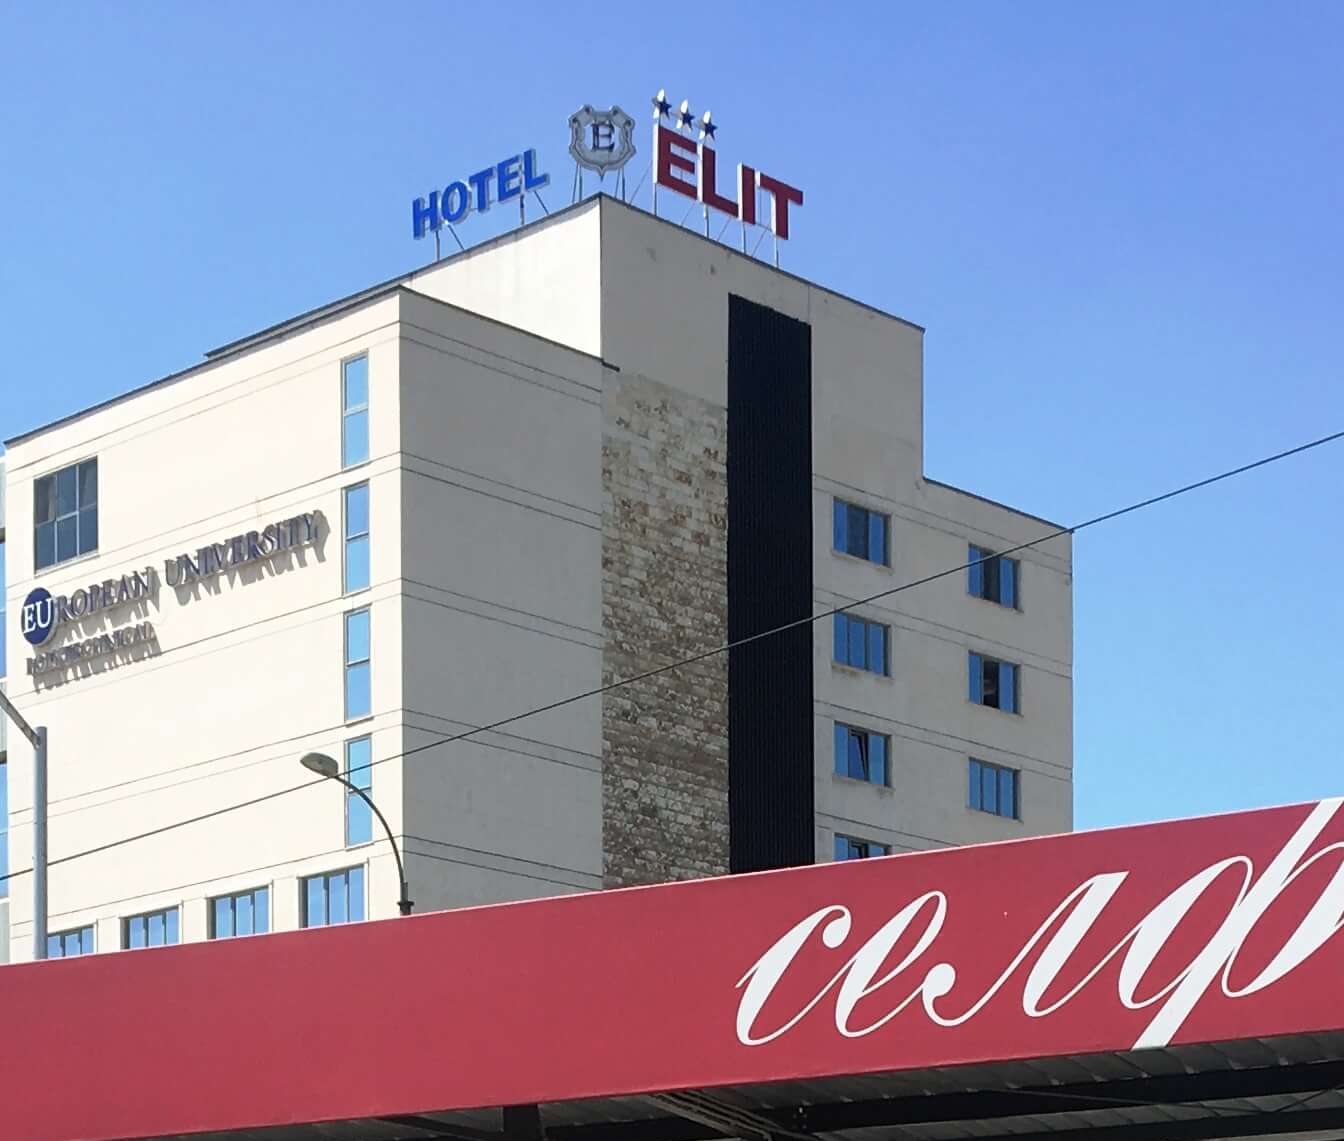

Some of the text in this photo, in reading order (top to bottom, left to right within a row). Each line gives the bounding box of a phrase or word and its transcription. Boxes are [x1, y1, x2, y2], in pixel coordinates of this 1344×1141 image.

[412, 122, 804, 241] HOTEL ELIT
[164, 509, 329, 588] UNIVERSITY
